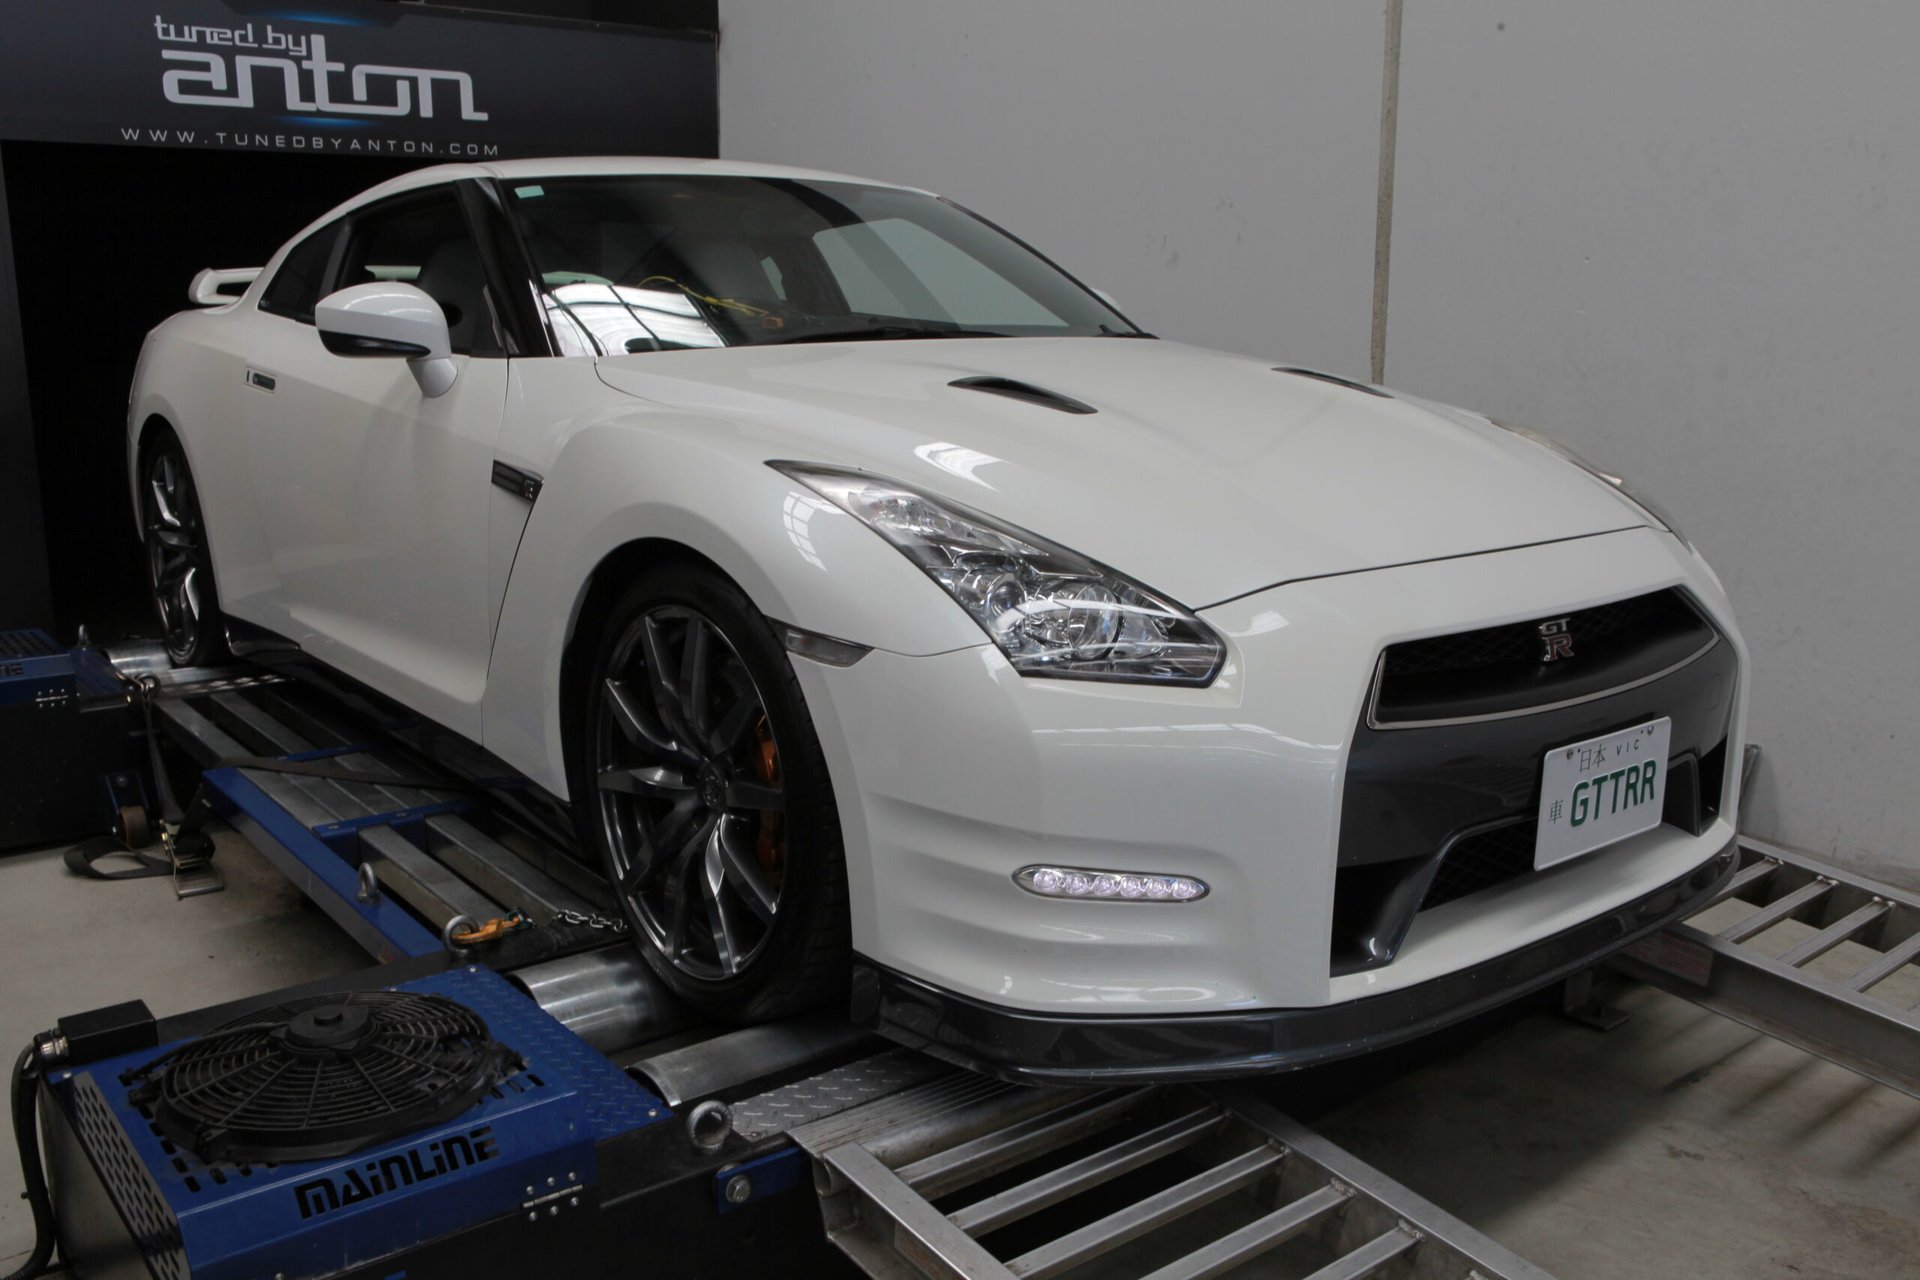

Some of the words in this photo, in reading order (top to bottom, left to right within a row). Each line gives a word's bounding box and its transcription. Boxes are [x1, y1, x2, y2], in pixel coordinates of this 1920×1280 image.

[154, 15, 258, 47] tuned
[262, 25, 307, 55] by
[161, 34, 489, 121] anton
[121, 128, 499, 156] WWW.TUNEDBYANTON.COM
[1580, 744, 1607, 772] 日本
[1616, 739, 1640, 756] VIC
[1571, 760, 1656, 827] GTTRR
